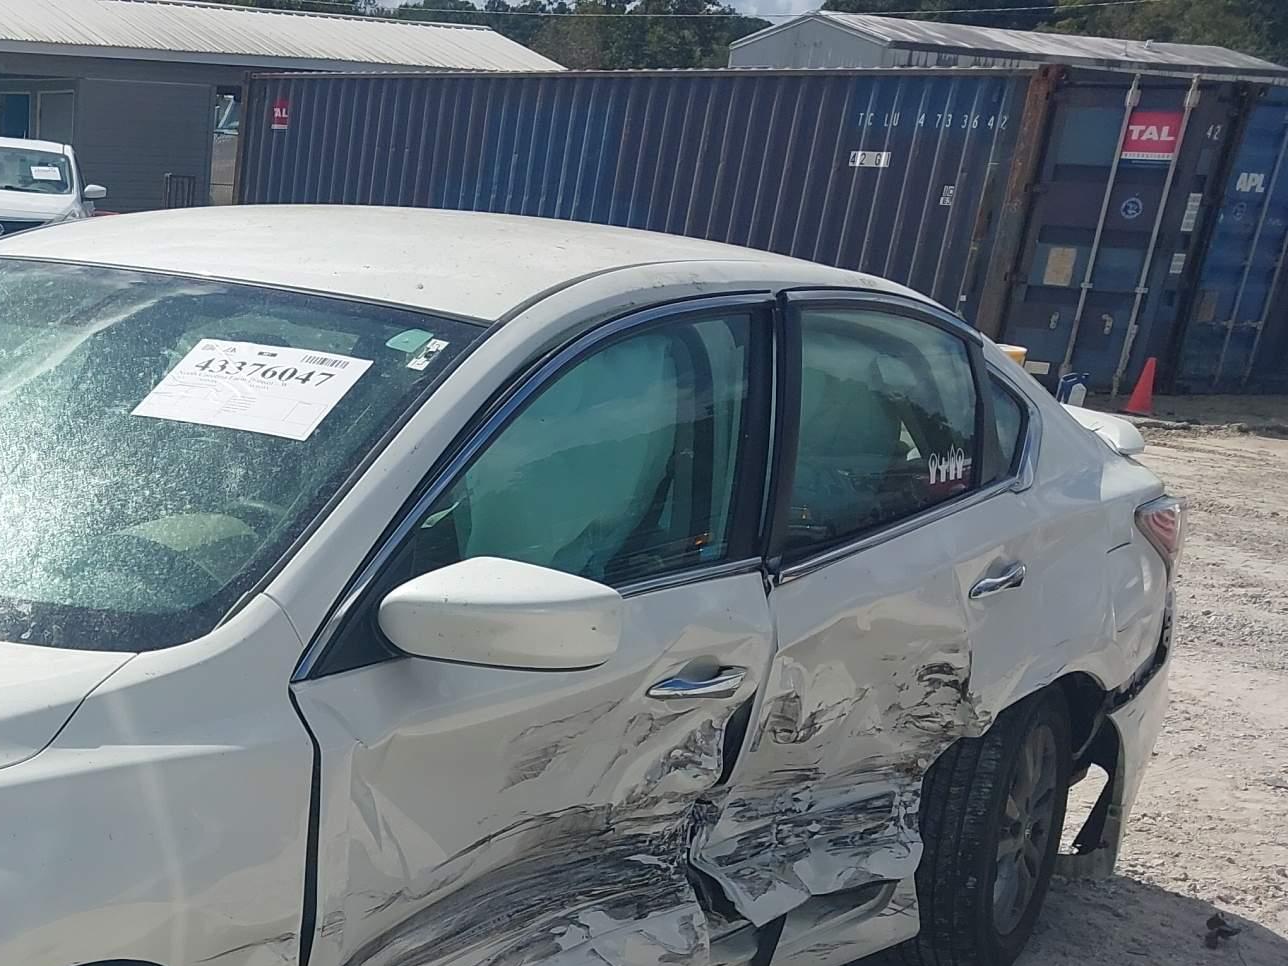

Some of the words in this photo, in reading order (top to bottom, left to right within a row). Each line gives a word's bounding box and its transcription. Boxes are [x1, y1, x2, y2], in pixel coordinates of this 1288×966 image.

[1128, 124, 1176, 141] TAL
[1235, 172, 1265, 193] APL
[194, 357, 337, 388] 43376047
